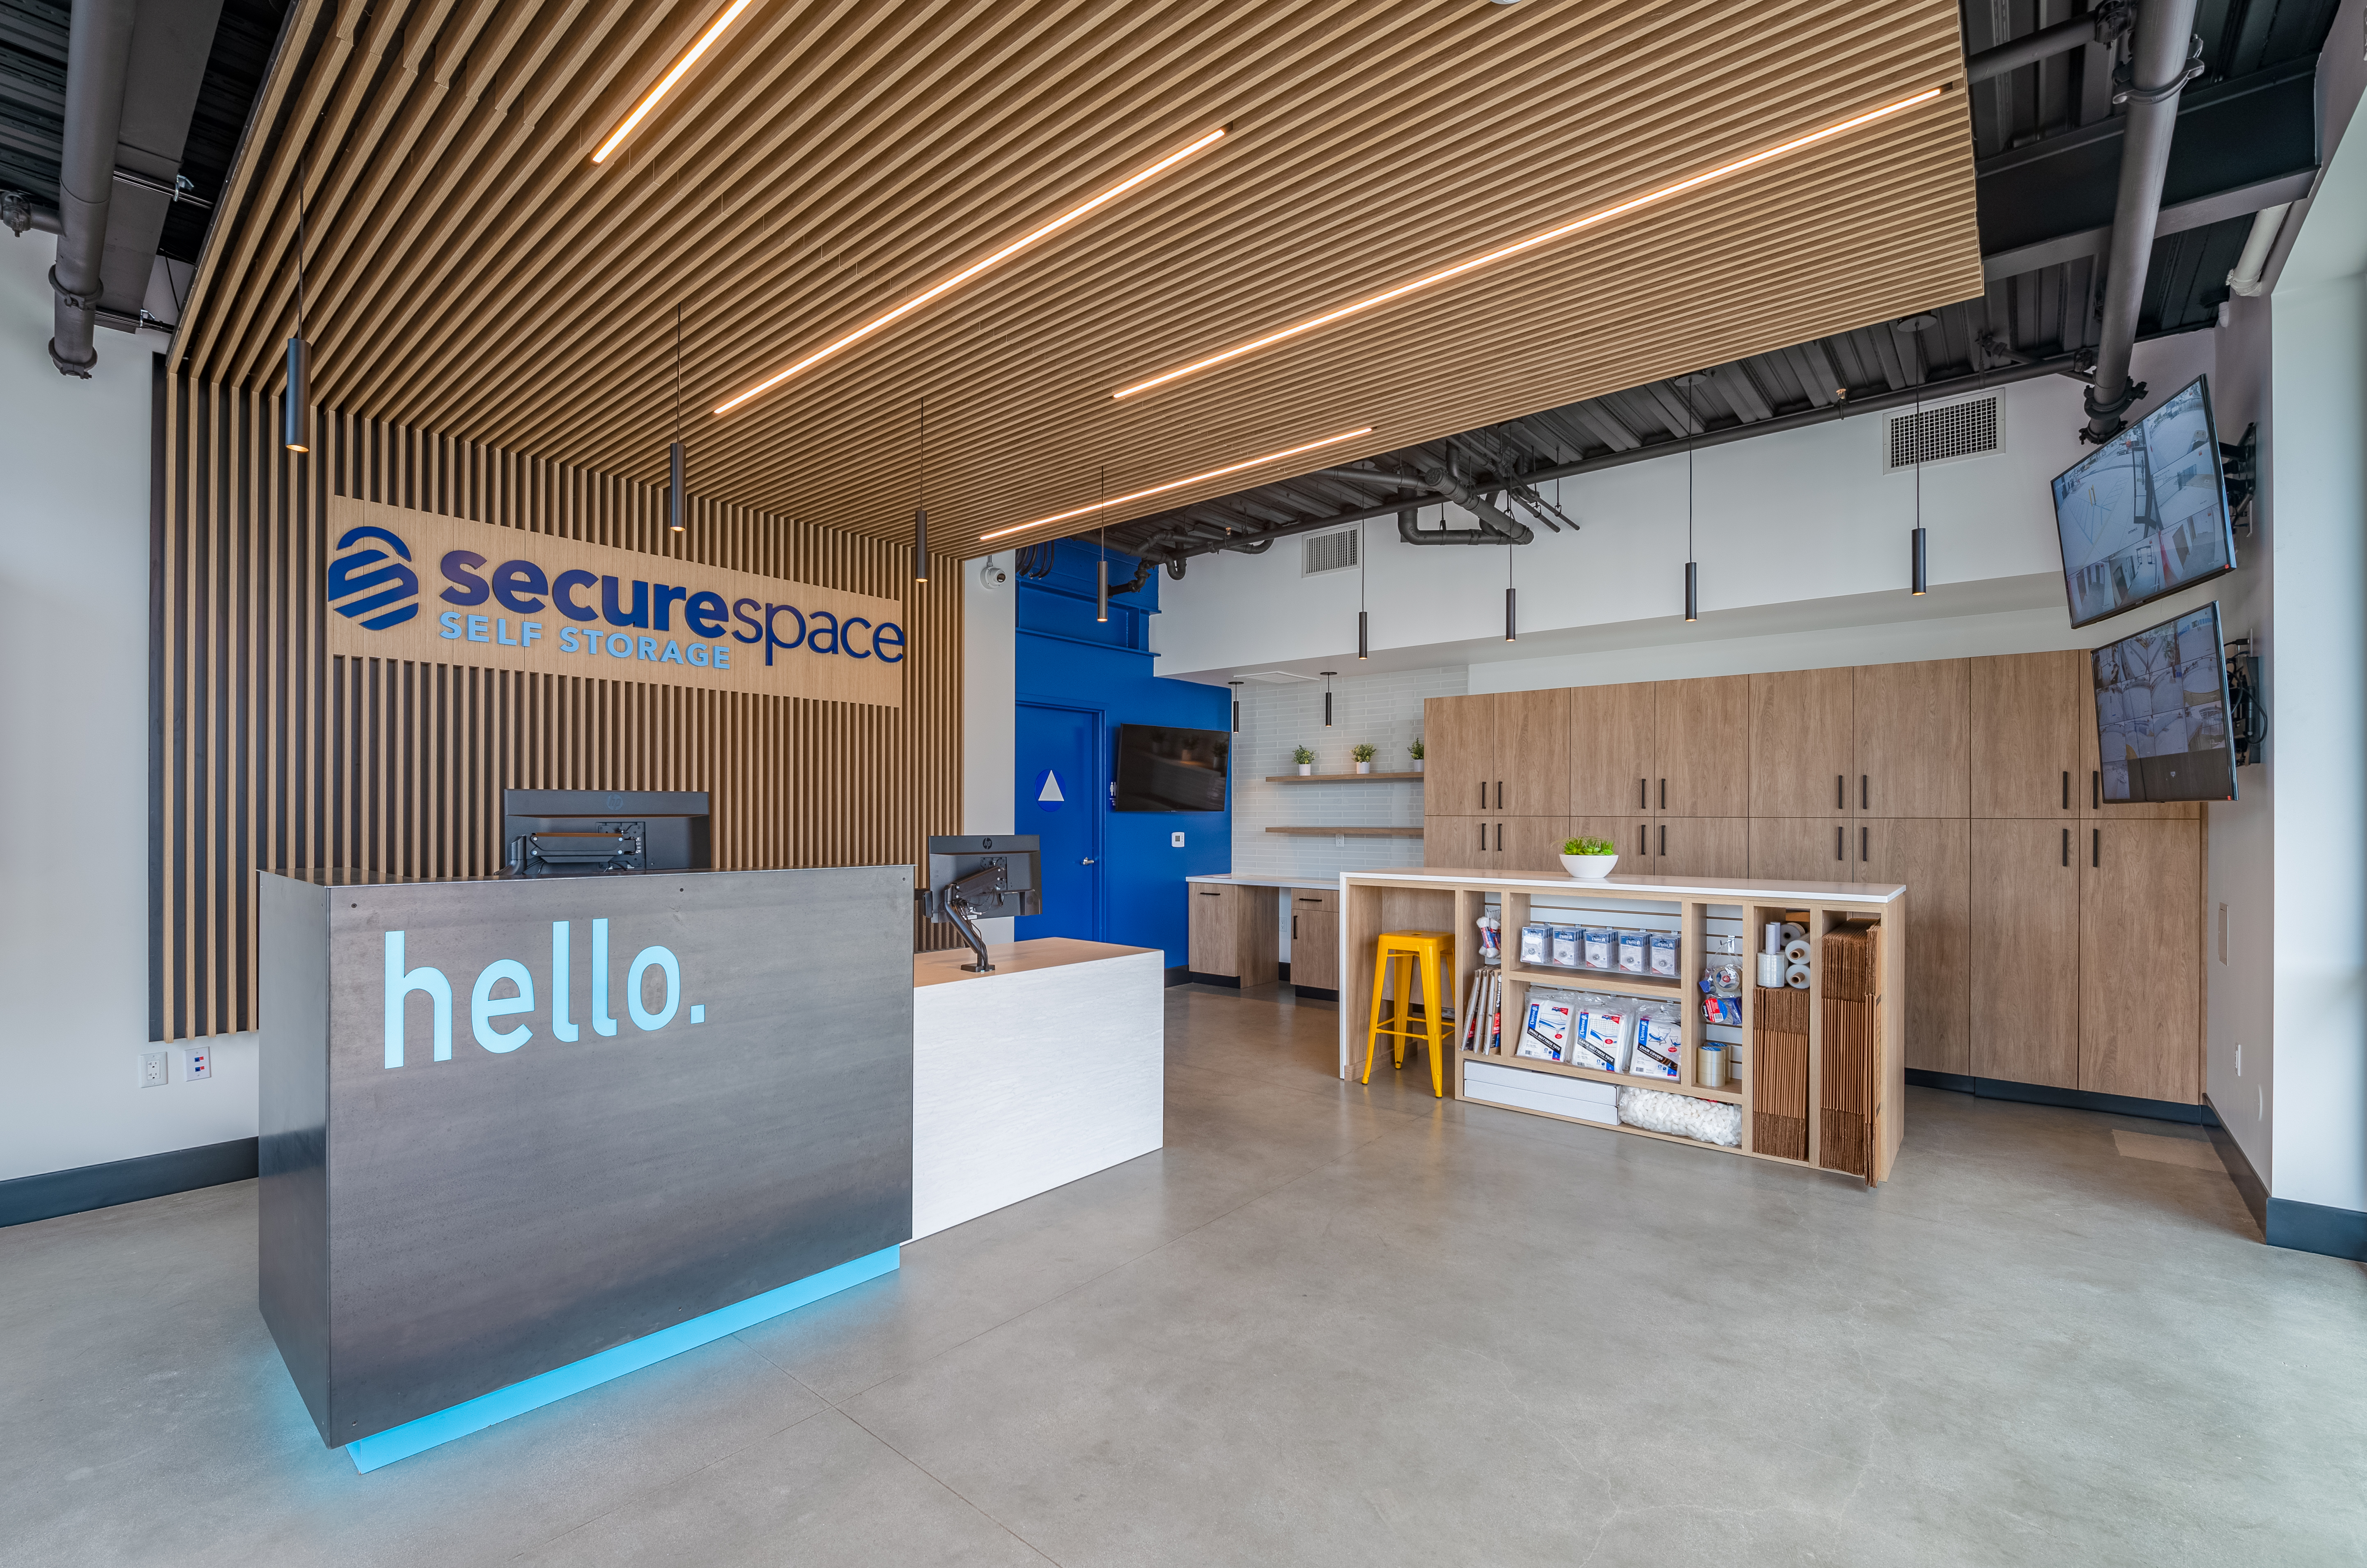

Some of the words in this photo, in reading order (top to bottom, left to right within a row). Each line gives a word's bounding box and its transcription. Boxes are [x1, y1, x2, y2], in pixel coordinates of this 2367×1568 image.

[439, 549, 905, 666] securespace
[439, 611, 542, 647] SELF
[559, 626, 731, 670] STORAGE
[983, 837, 992, 849] hp
[385, 918, 705, 1069] hello.
[1538, 1034, 1553, 1046] MATTRESS
[1589, 1045, 1605, 1057] MATTRESS
[1650, 1051, 1663, 1060] COVERS
